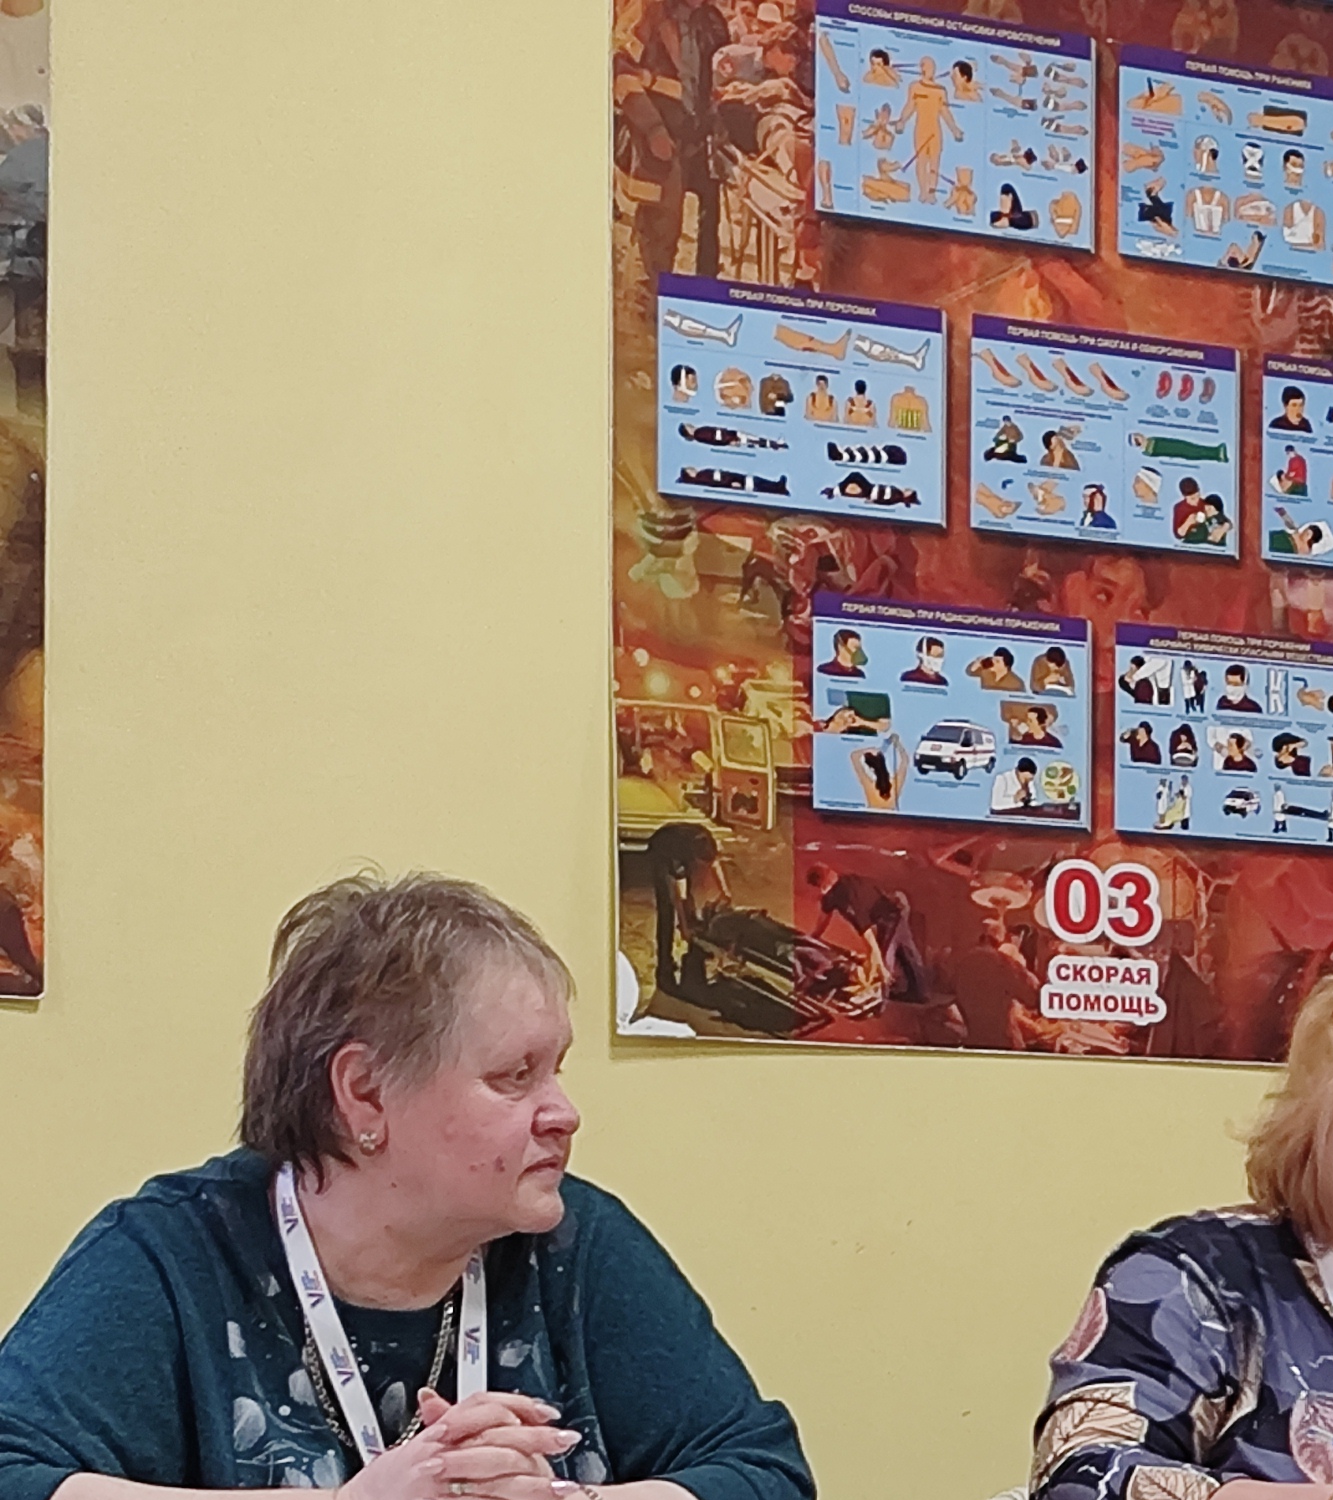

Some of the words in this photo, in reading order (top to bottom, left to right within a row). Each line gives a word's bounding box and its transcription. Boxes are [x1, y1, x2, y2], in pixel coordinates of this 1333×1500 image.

[1052, 865, 1156, 940] 03
[1055, 963, 1151, 986] СКОРАЯ
[1048, 992, 1159, 1017] ПОМОЩЬ
